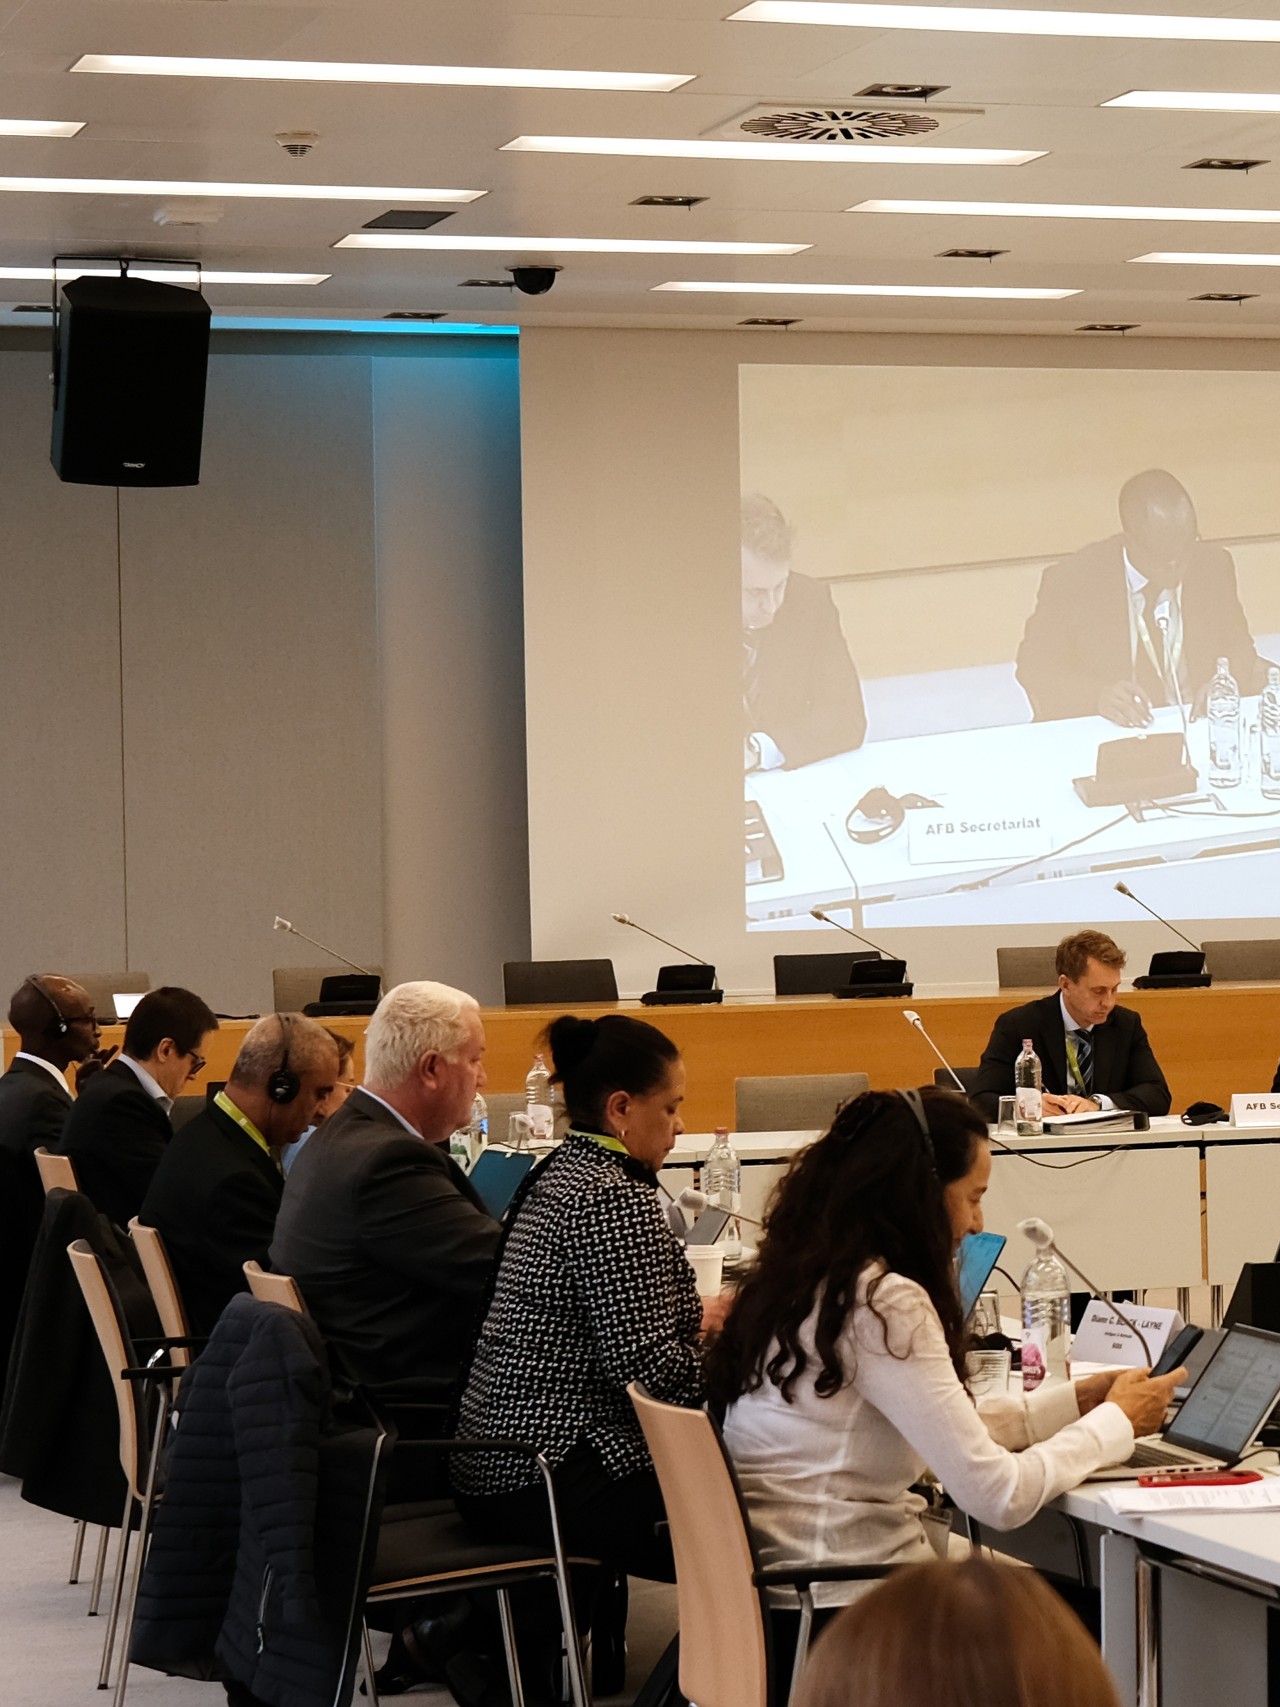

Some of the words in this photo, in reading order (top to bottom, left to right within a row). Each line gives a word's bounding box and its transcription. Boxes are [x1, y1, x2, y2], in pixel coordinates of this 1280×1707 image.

[925, 822, 955, 836] AFB
[959, 817, 1041, 834] Secretariat
[1245, 1102, 1266, 1110] AFB
